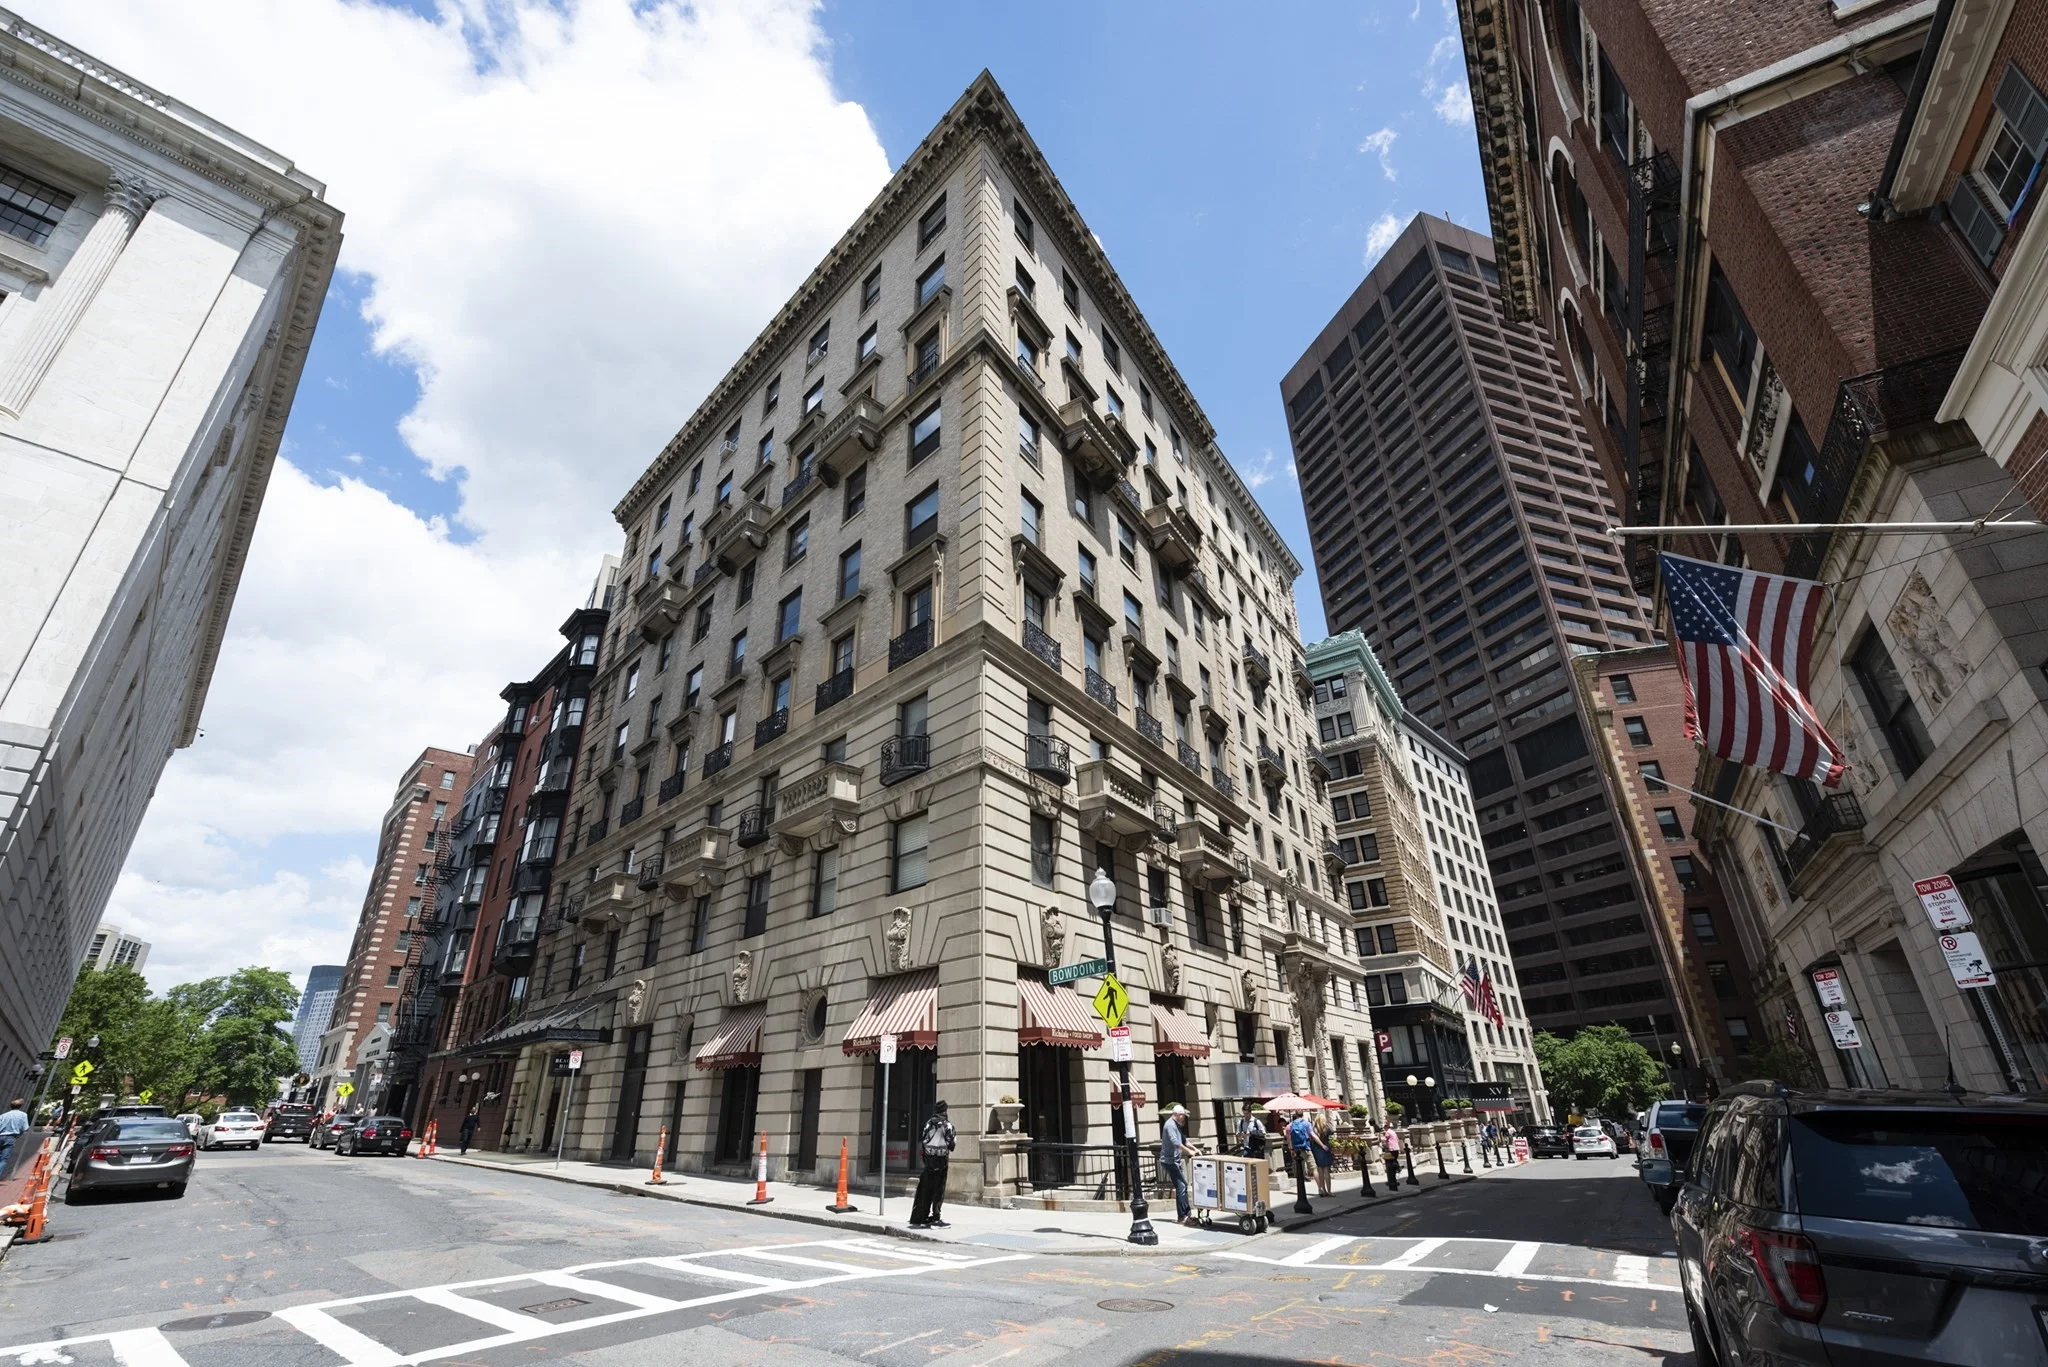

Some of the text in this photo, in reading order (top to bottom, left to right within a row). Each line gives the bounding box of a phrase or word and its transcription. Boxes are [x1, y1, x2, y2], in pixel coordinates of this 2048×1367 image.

[1917, 879, 1951, 892] TOW ZONE
[1931, 893, 1946, 901] NO
[1927, 898, 1957, 908] STOPPING
[1052, 962, 1095, 982] BOWDOIN
[1082, 1032, 1094, 1040] SHOPS
[1379, 1034, 1389, 1047] P
[1489, 1087, 1503, 1096] XV
